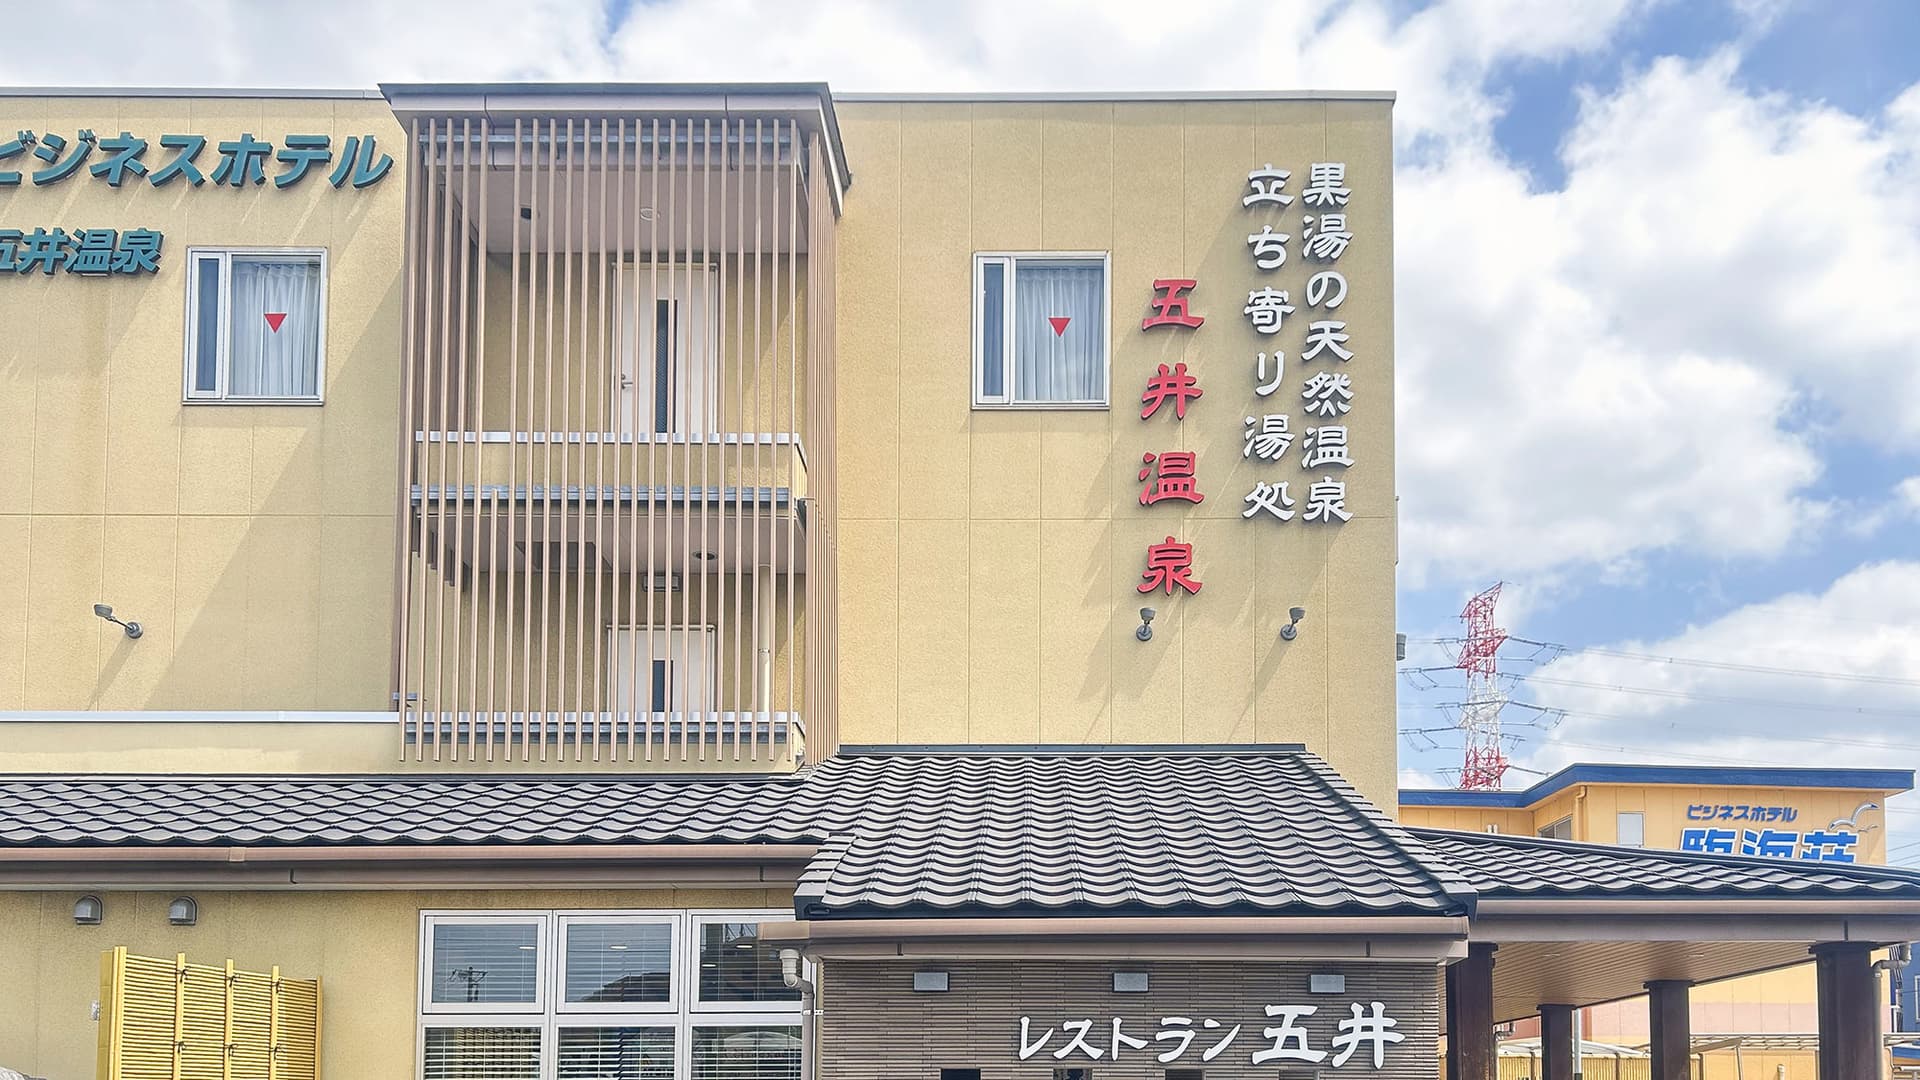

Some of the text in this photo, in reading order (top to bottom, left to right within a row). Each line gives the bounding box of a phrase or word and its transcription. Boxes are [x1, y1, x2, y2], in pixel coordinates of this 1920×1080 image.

[1137, 279, 1205, 596] 五井温泉
[1242, 163, 1296, 522] 立ち寄り湯処
[1301, 163, 1355, 523] 黒湯の天然温泉
[1687, 804, 1798, 823] ビジネスホテル
